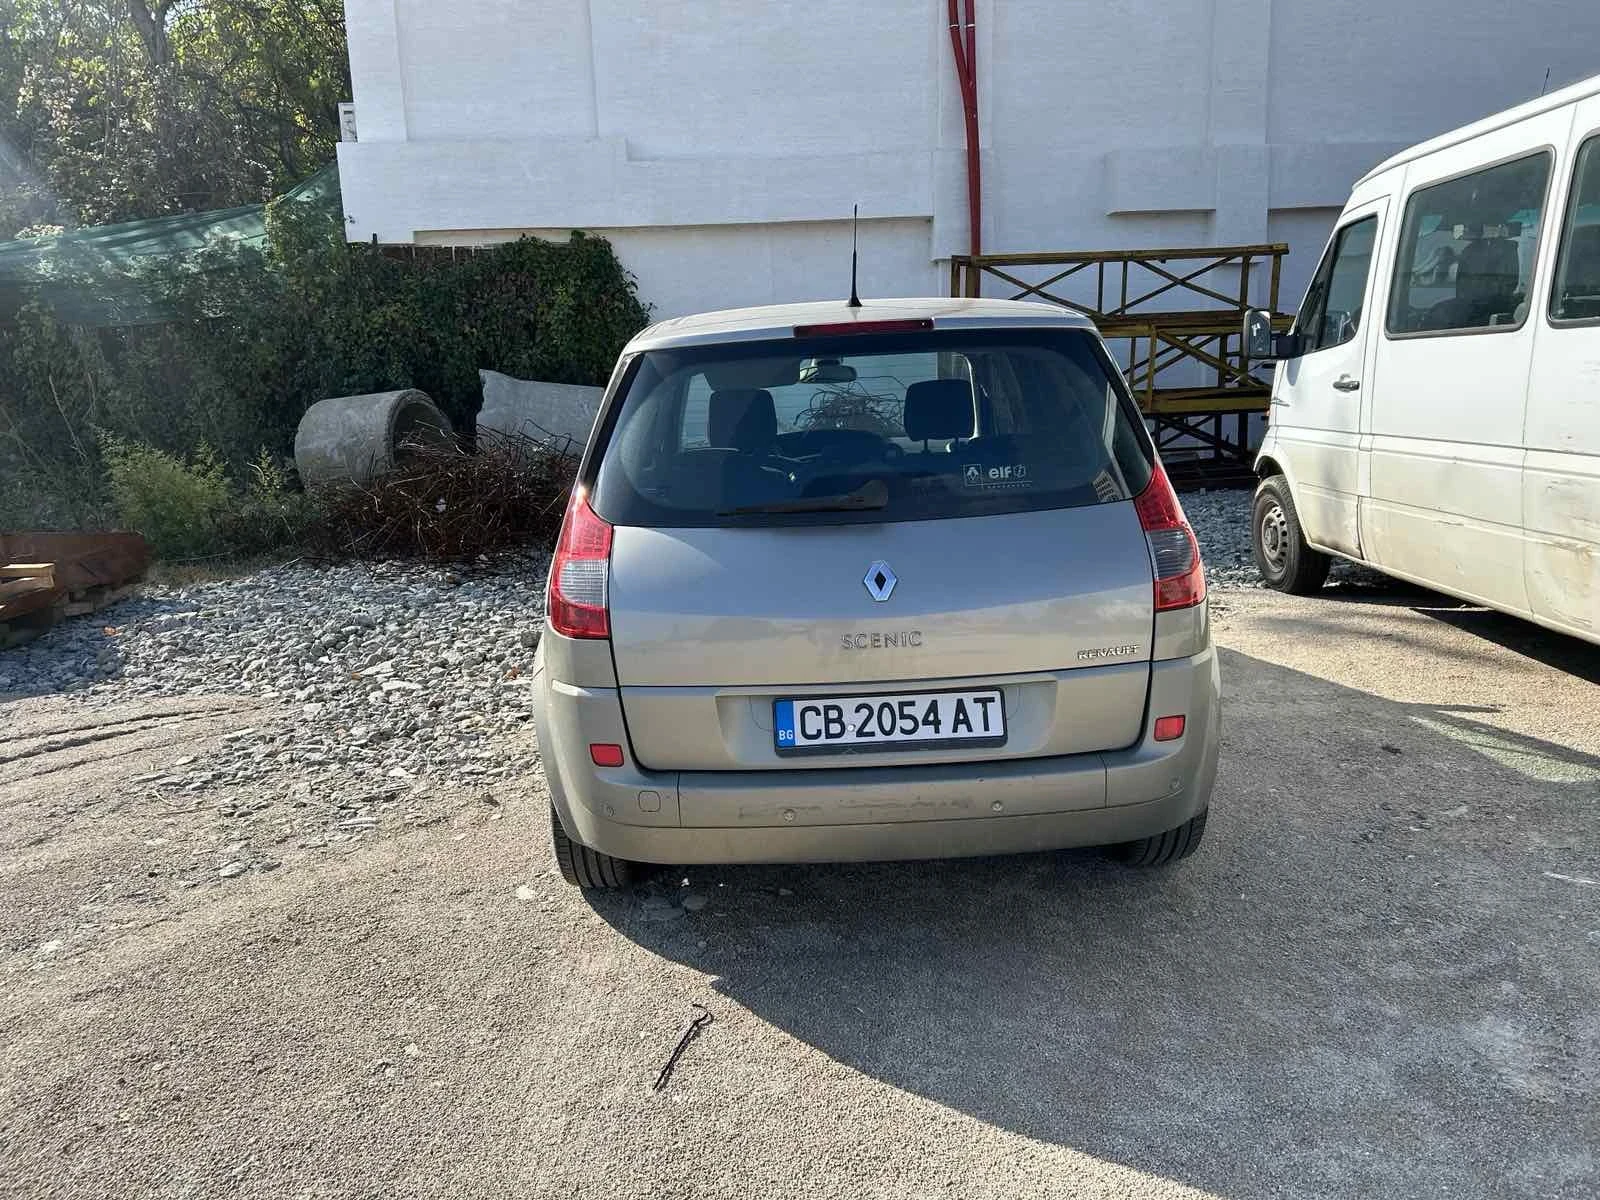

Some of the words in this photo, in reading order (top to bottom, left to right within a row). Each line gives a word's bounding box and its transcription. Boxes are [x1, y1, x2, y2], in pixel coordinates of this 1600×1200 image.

[988, 465, 1012, 479] elf
[841, 631, 922, 650] SCENIC
[1077, 644, 1140, 661] RENAULT
[799, 704, 845, 740] CB
[854, 699, 942, 738] 2054
[951, 696, 996, 734] AT
[778, 729, 794, 741] BG
